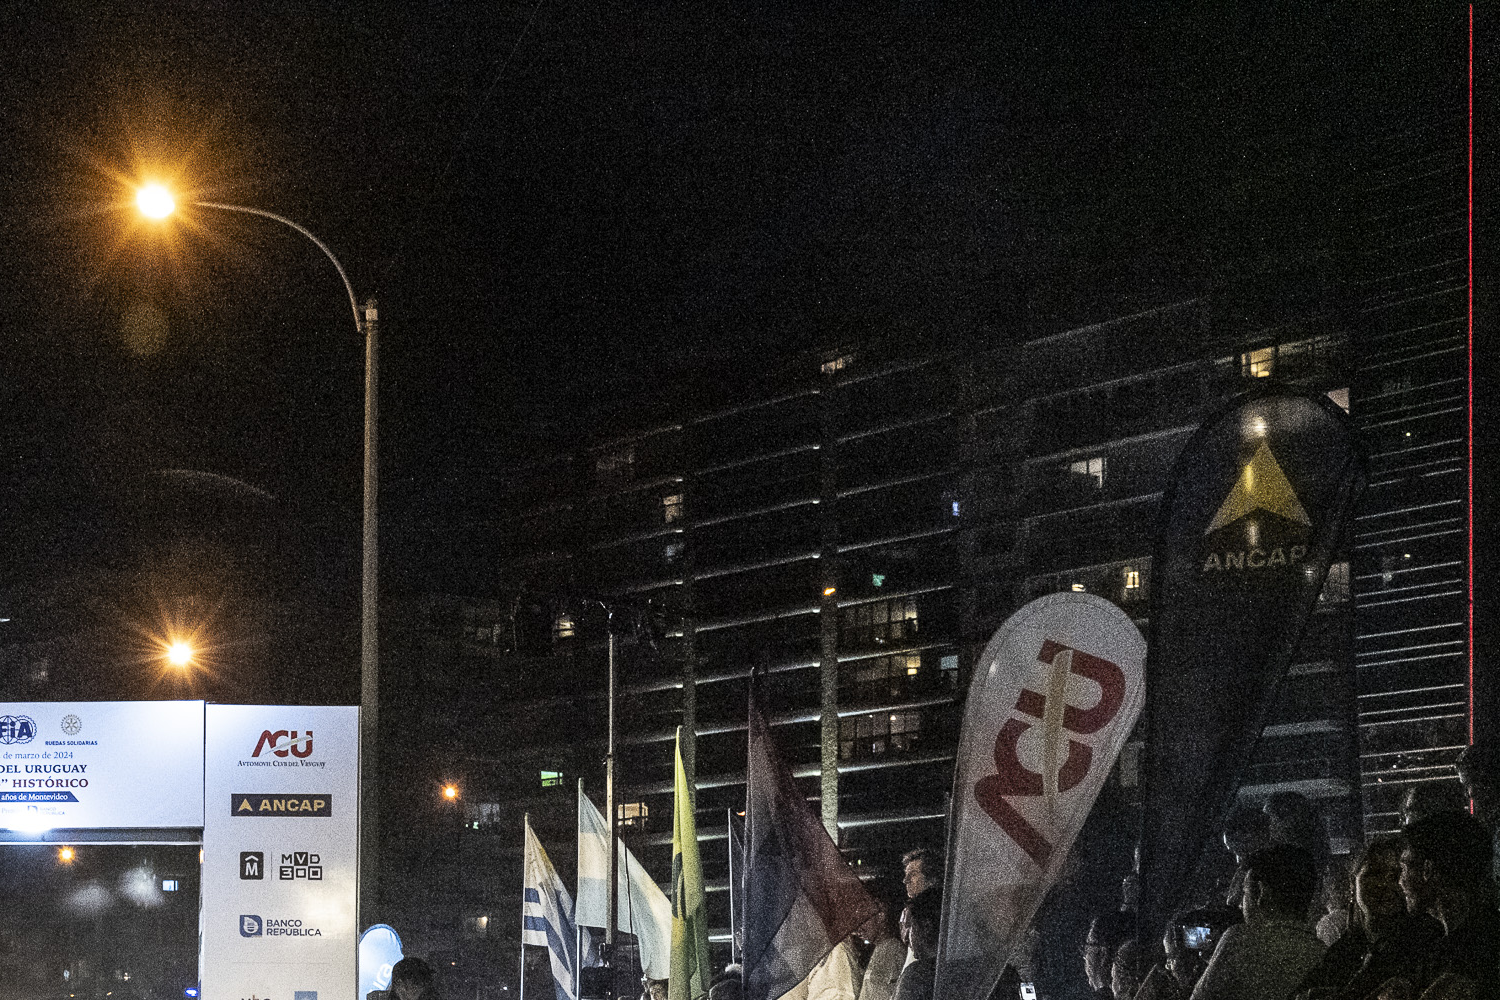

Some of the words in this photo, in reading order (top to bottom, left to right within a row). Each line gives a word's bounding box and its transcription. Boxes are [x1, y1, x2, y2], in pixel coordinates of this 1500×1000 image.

[1202, 545, 1307, 572] ANCAP
[251, 729, 314, 758] ACU
[3, 751, 13, 760] de
[14, 752, 40, 760] marzo
[41, 751, 52, 760] de
[53, 751, 74, 760] 2024
[25, 764, 88, 774] URUGUAY
[12, 775, 89, 788] HISTÓRICO
[1, 793, 17, 801] años
[18, 793, 27, 801] de
[28, 793, 69, 801] Montevideo
[259, 799, 326, 812] ANCAP
[281, 851, 321, 866] MVD
[280, 866, 323, 881] 300
[266, 919, 303, 927] BANCO
